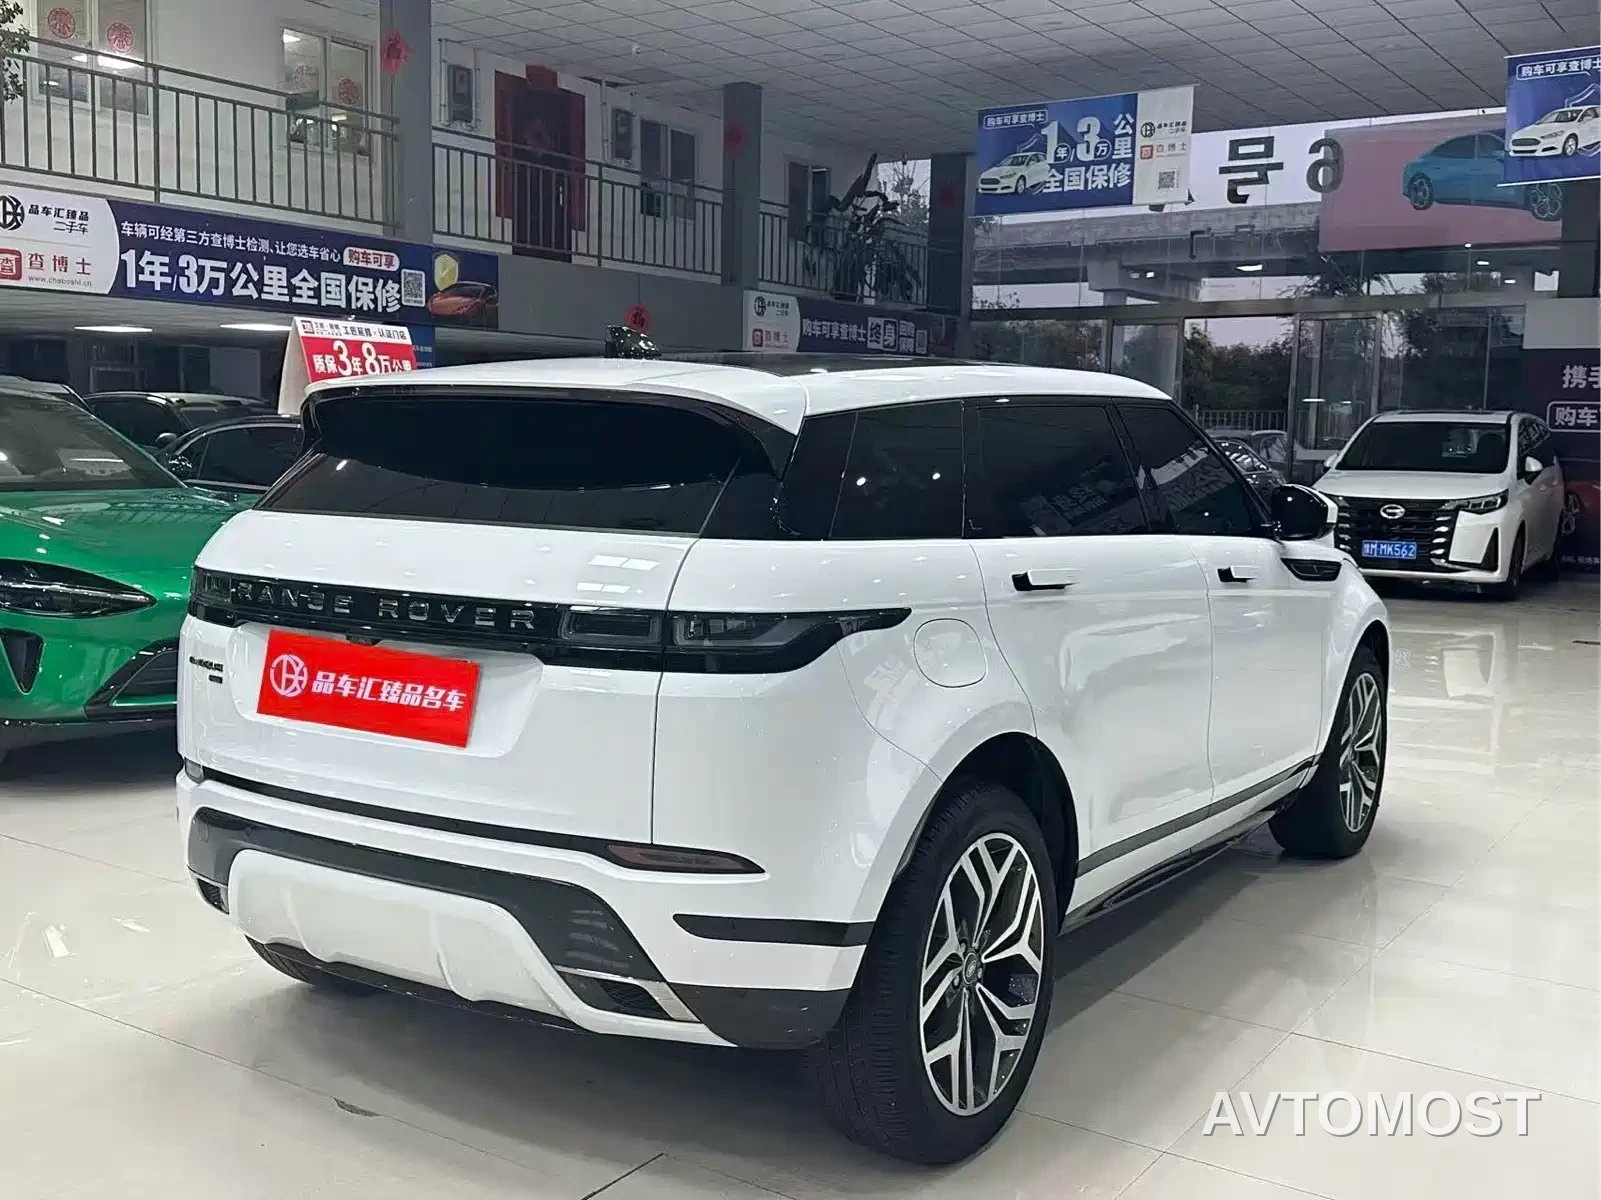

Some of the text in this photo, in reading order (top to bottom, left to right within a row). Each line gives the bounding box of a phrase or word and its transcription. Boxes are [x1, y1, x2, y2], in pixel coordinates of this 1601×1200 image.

[1042, 162, 1132, 193] 全国保修
[53, 221, 89, 235] 二手车
[28, 252, 91, 275] 查博士
[348, 248, 395, 268] 购车可享
[237, 581, 536, 630] RANGE ROVER
[312, 670, 467, 712] 品车汇臻品名车
